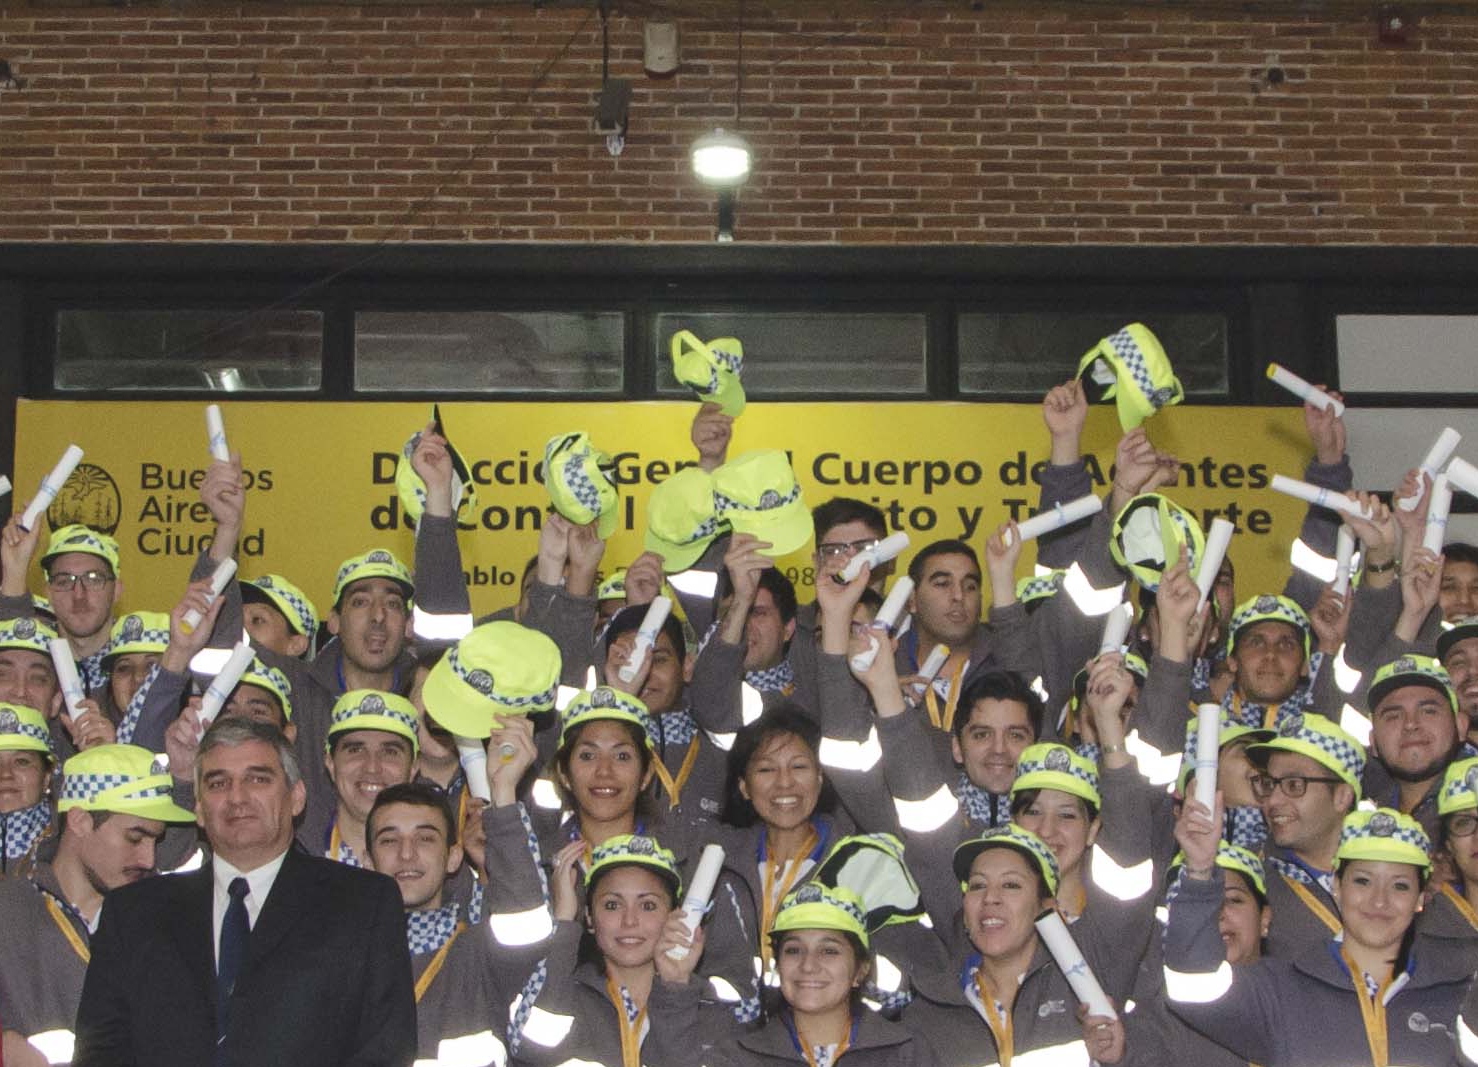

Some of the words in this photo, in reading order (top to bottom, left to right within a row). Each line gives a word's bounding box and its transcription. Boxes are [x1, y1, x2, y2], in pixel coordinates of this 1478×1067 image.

[140, 463, 274, 490] Bueos
[812, 452, 983, 494] Cuerpo
[138, 494, 220, 523] Aire
[137, 528, 265, 556] Ciudd
